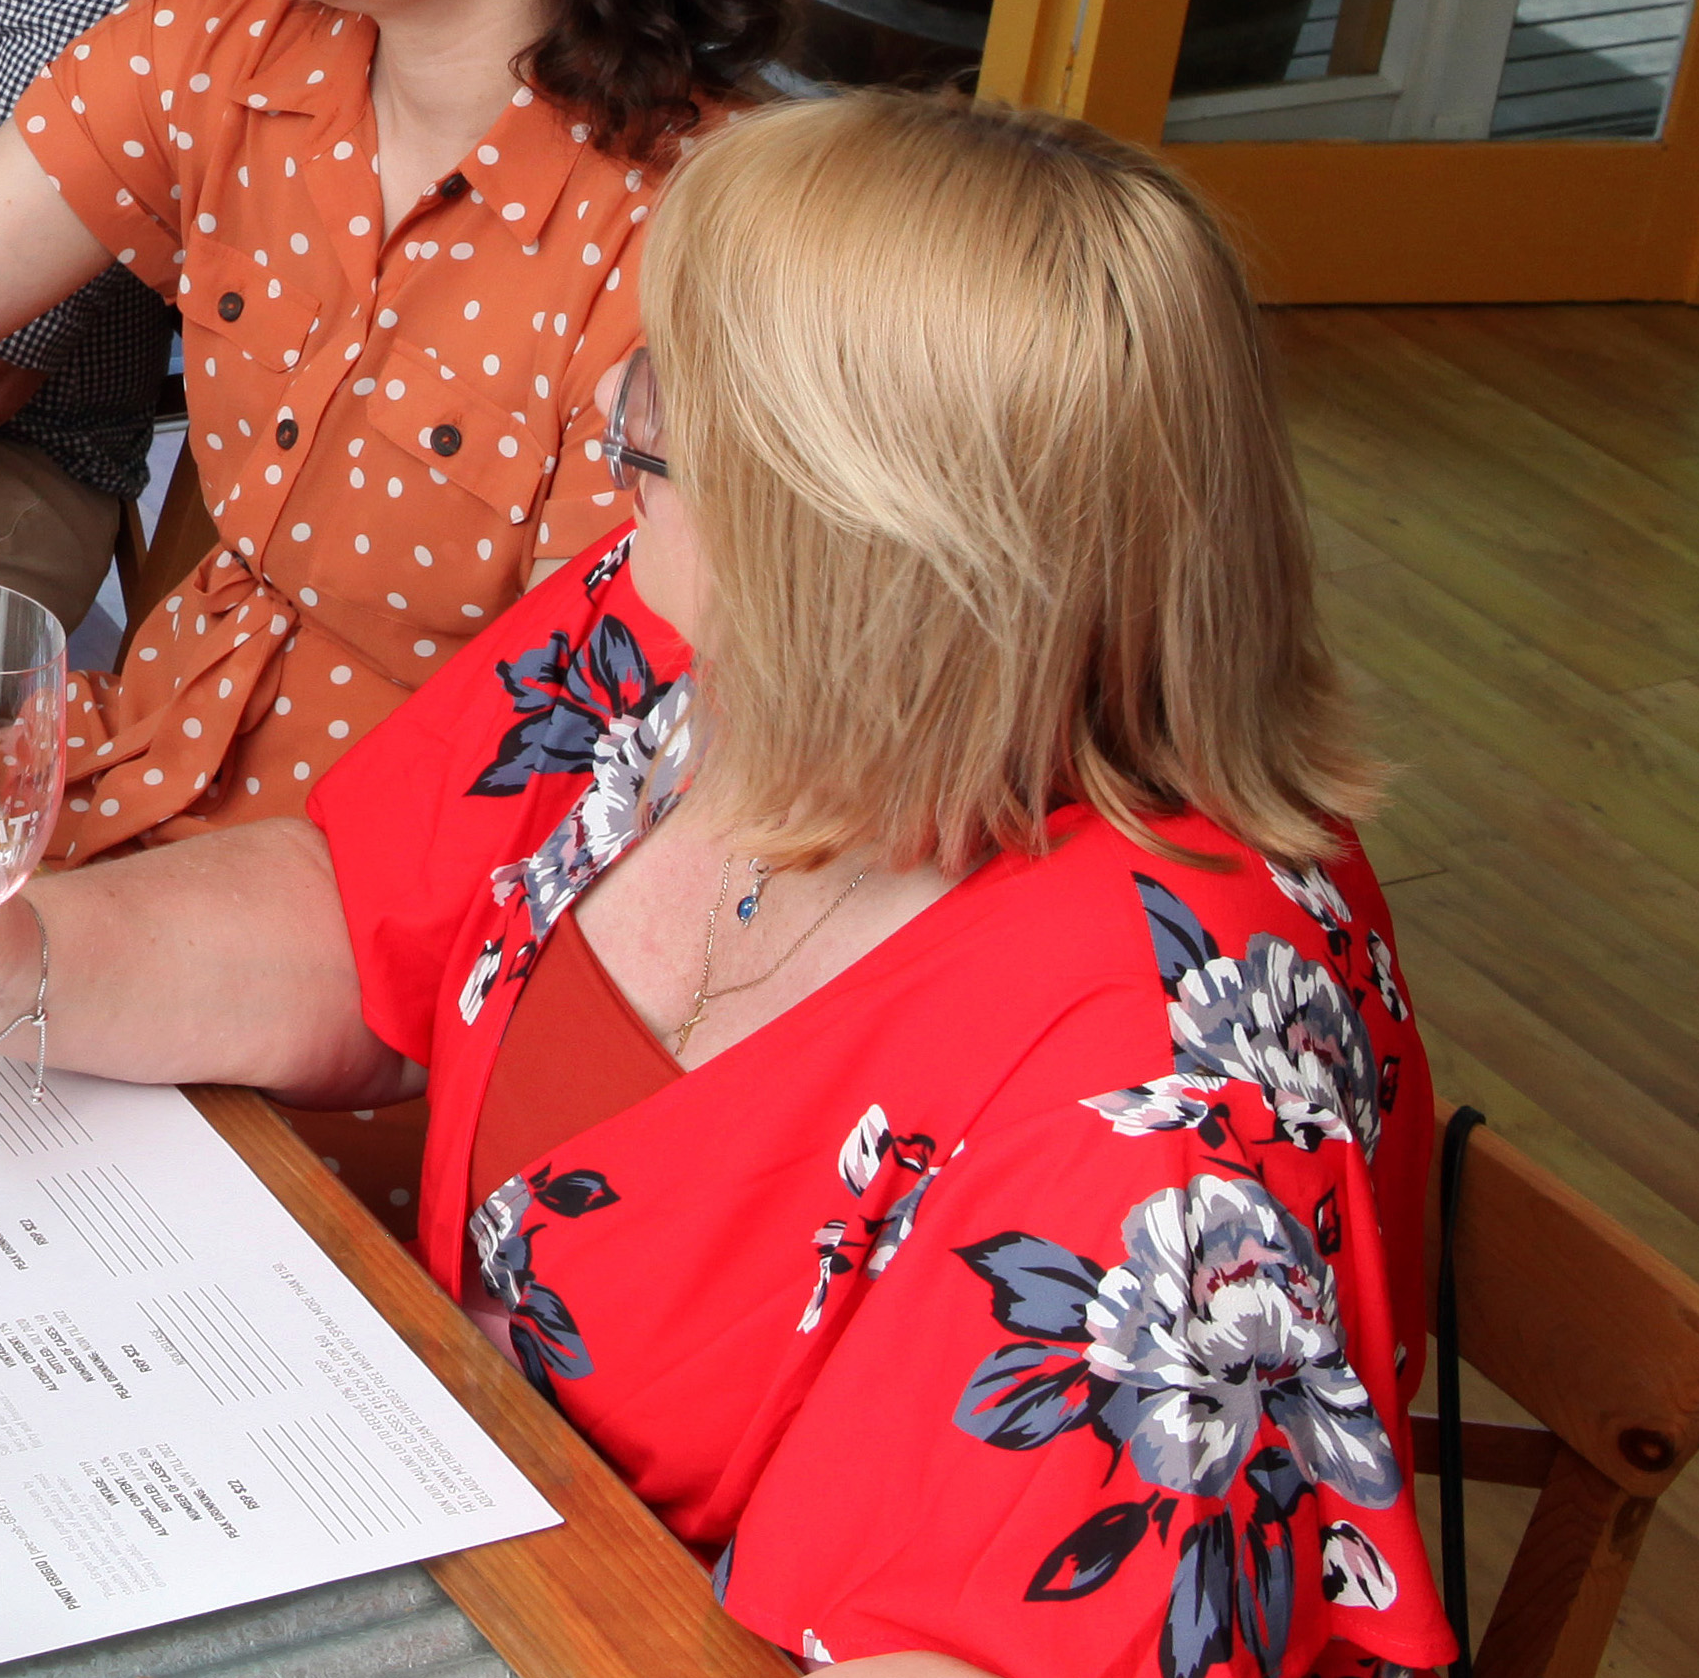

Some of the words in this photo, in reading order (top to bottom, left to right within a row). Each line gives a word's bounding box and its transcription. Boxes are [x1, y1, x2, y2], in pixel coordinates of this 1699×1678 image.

[20, 1219, 37, 1231] $22
[30, 1232, 49, 1245] RRP
[286, 1279, 308, 1296] THAN
[301, 1297, 326, 1315] MORE
[318, 1315, 344, 1337] SPEND
[315, 1335, 334, 1348] $60
[337, 1337, 359, 1351] YOU
[121, 1344, 140, 1358] $22
[326, 1348, 345, 1361] FOR
[132, 1359, 152, 1372] RRP
[315, 1360, 335, 1373] RRP
[349, 1351, 374, 1371] WHEN
[327, 1373, 346, 1387] THE
[343, 1367, 361, 1378] OR
[366, 1372, 390, 1389] FREE
[352, 1378, 376, 1396] EACH
[368, 1396, 388, 1409] $15
[382, 1389, 423, 1426] DELIVERIES
[352, 1403, 384, 1430] RECEIVE
[377, 1430, 394, 1440] TO
[384, 1414, 417, 1444] GLASSES
[385, 1441, 406, 1455] LIST
[412, 1443, 440, 1468] RIEDEL
[415, 1426, 467, 1475] METROPOLITAN
[169, 1458, 186, 1472] TILL
[399, 1455, 432, 1483] MAILING
[164, 1484, 179, 1492] OF
[178, 1472, 199, 1488] NOW
[228, 1479, 247, 1494] $22
[430, 1469, 461, 1494] SKINNY
[424, 1483, 445, 1499] OUR
[459, 1476, 496, 1507] ADELAIDE
[173, 1493, 202, 1521] NUMBER
[240, 1495, 260, 1509] RRP
[437, 1500, 460, 1515] JOIN
[139, 1507, 169, 1536] ALCOHOL
[219, 1521, 240, 1538] PEAK
[35, 1561, 62, 1586] GRIGIO
[54, 1588, 81, 1610] PINOT
